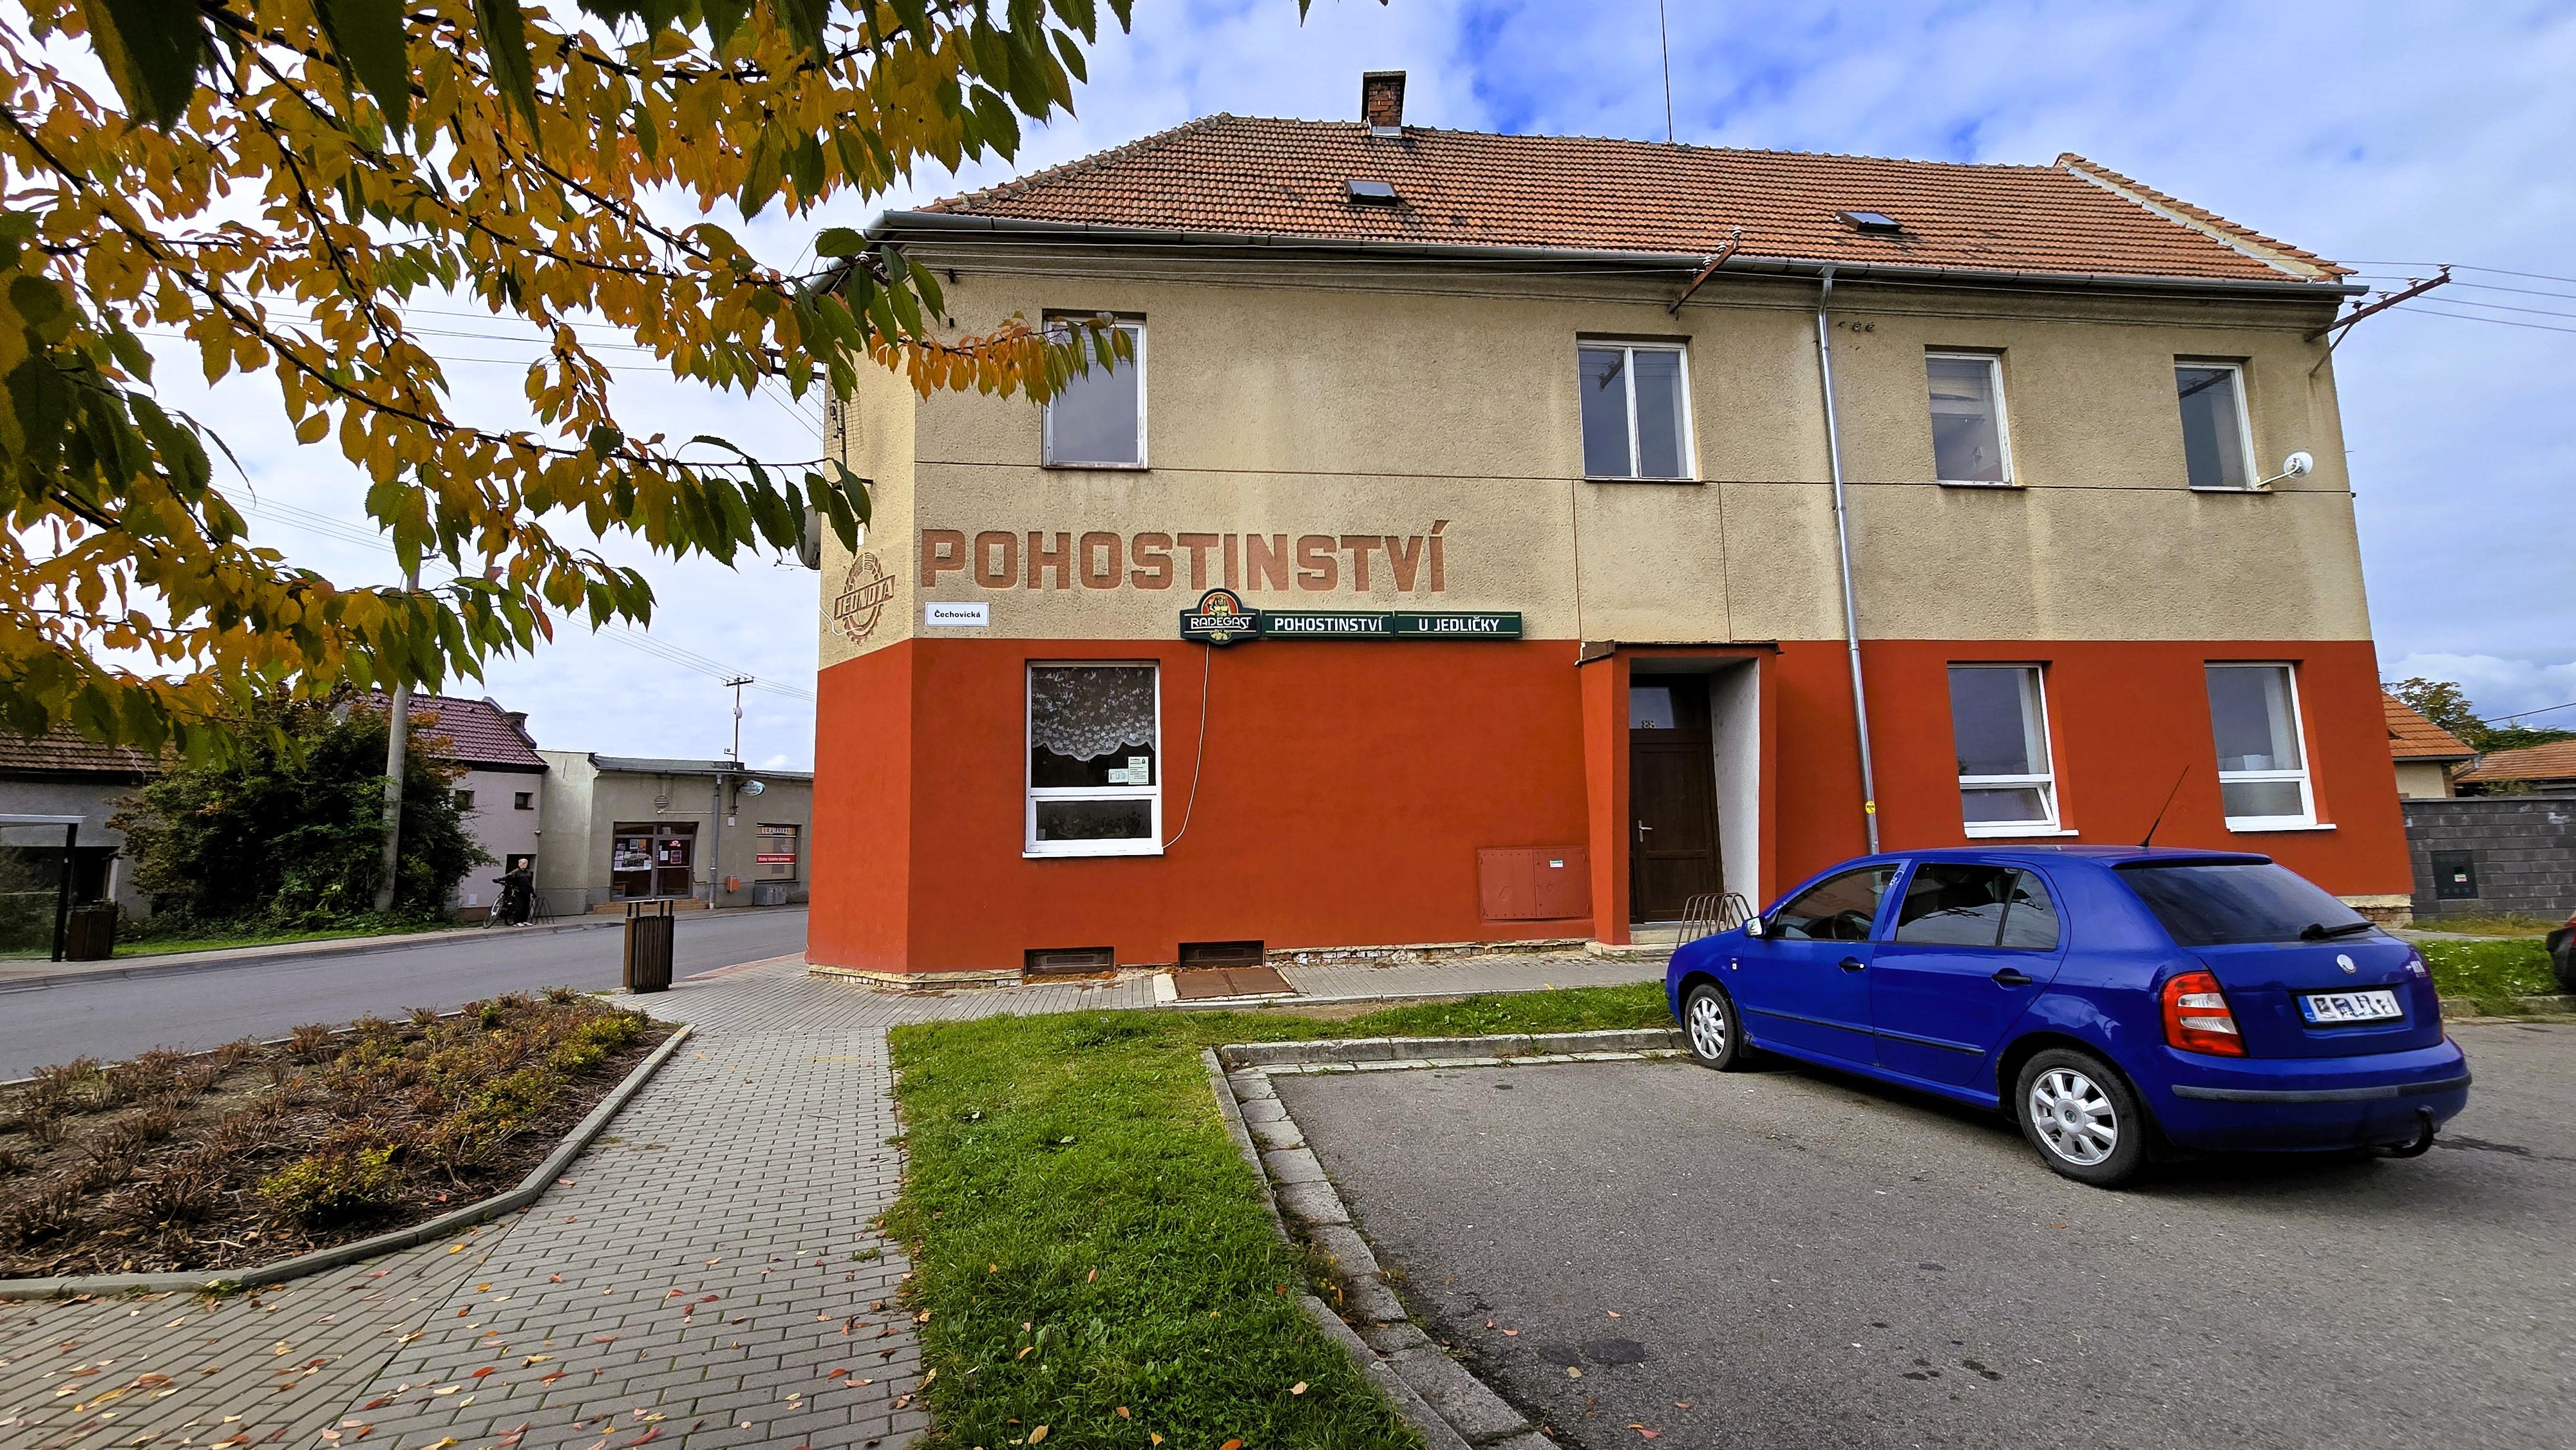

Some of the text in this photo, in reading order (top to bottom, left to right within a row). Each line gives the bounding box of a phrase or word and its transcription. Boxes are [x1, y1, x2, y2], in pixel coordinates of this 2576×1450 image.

[921, 520, 1450, 592] POHOSTINSTVÍ
[836, 578, 895, 618] JEDNOTA
[934, 609, 981, 618] Čechovická
[1191, 616, 1252, 630] RADEGAST
[1274, 616, 1500, 632] POHOSTINSTVÍ U JEDLIČKY
[1642, 719, 1657, 729] 88
